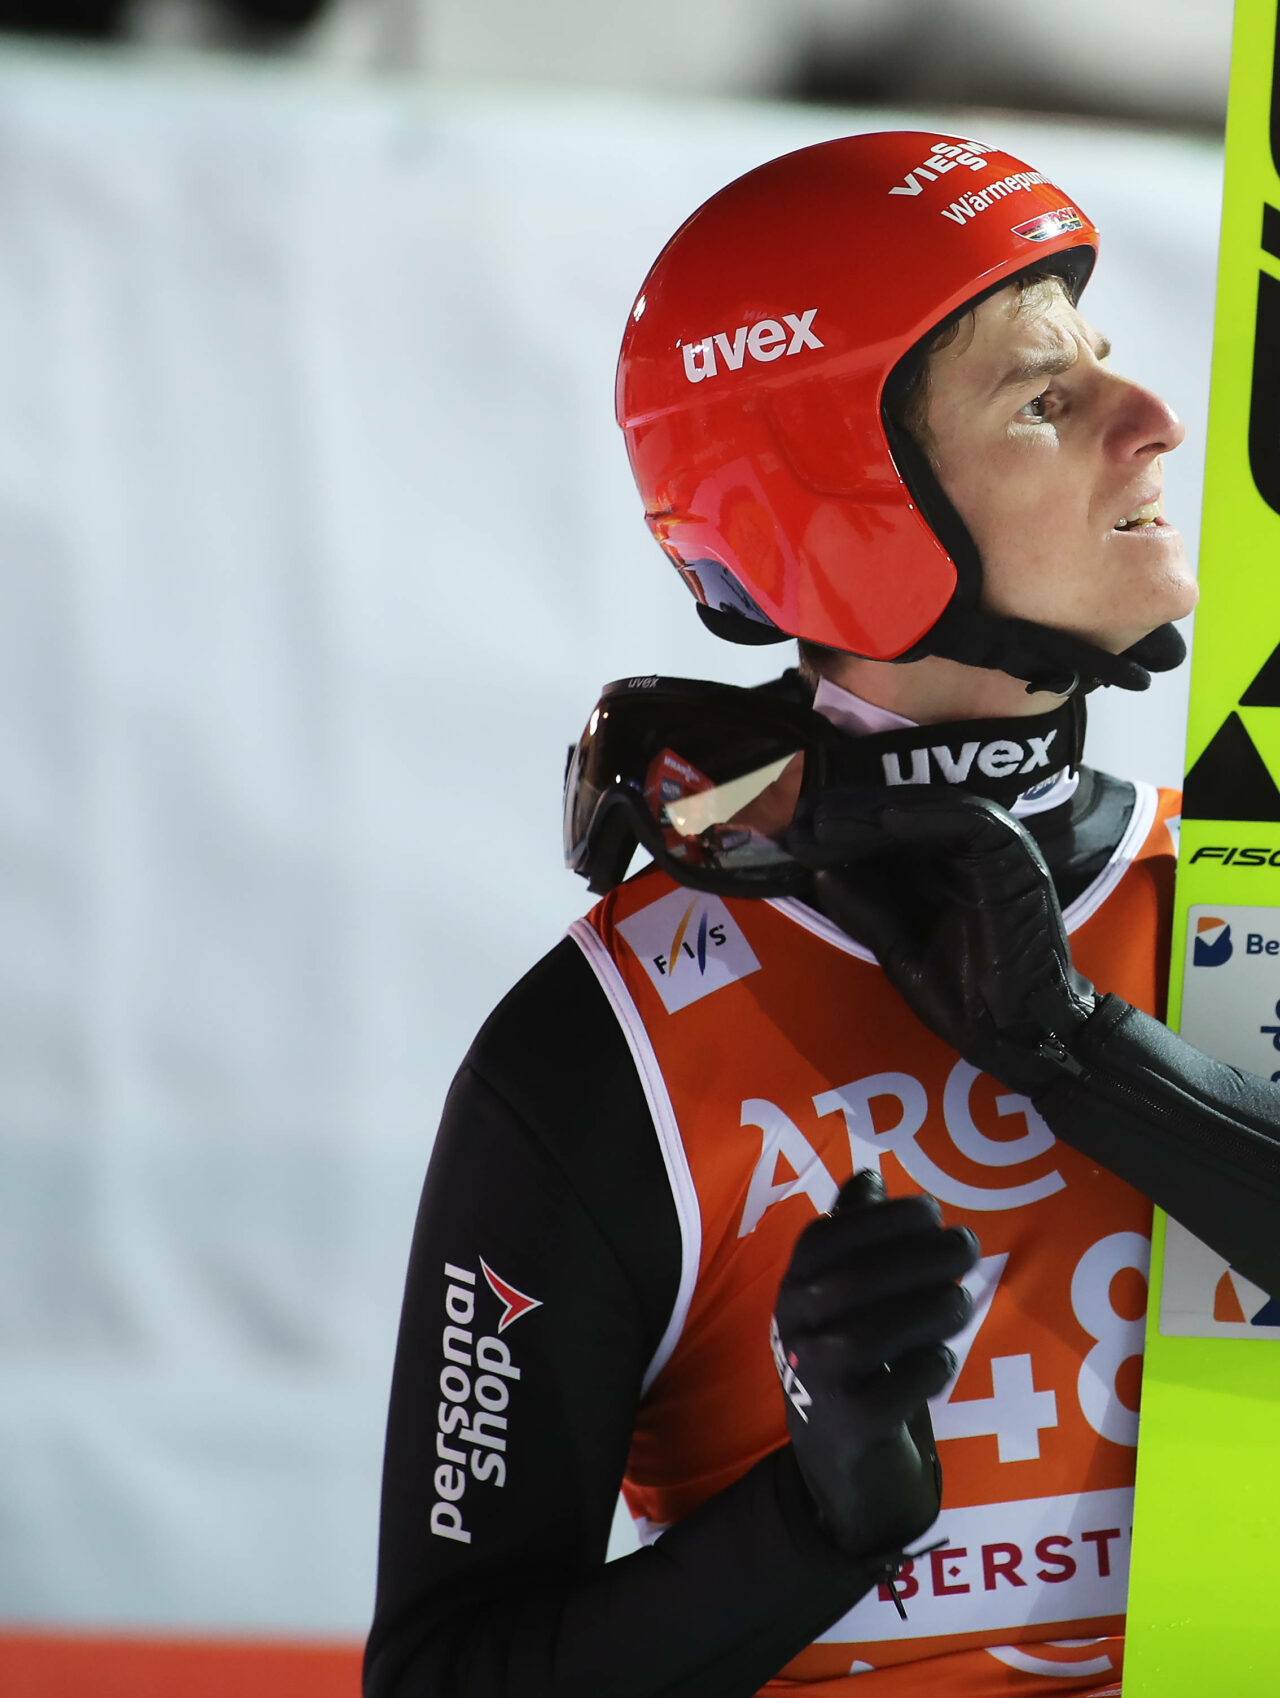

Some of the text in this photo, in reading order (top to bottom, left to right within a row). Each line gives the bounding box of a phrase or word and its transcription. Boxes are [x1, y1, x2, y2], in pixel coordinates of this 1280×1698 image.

[888, 141, 998, 196] VIESSM
[941, 171, 1060, 225] Wärmepum
[682, 308, 825, 383] uvex
[628, 677, 659, 688] uvex
[881, 729, 1058, 786] uvex
[653, 924, 727, 975] FIS
[926, 1231, 1151, 1464] 48
[430, 1262, 476, 1544] personal
[458, 1335, 521, 1488] shop
